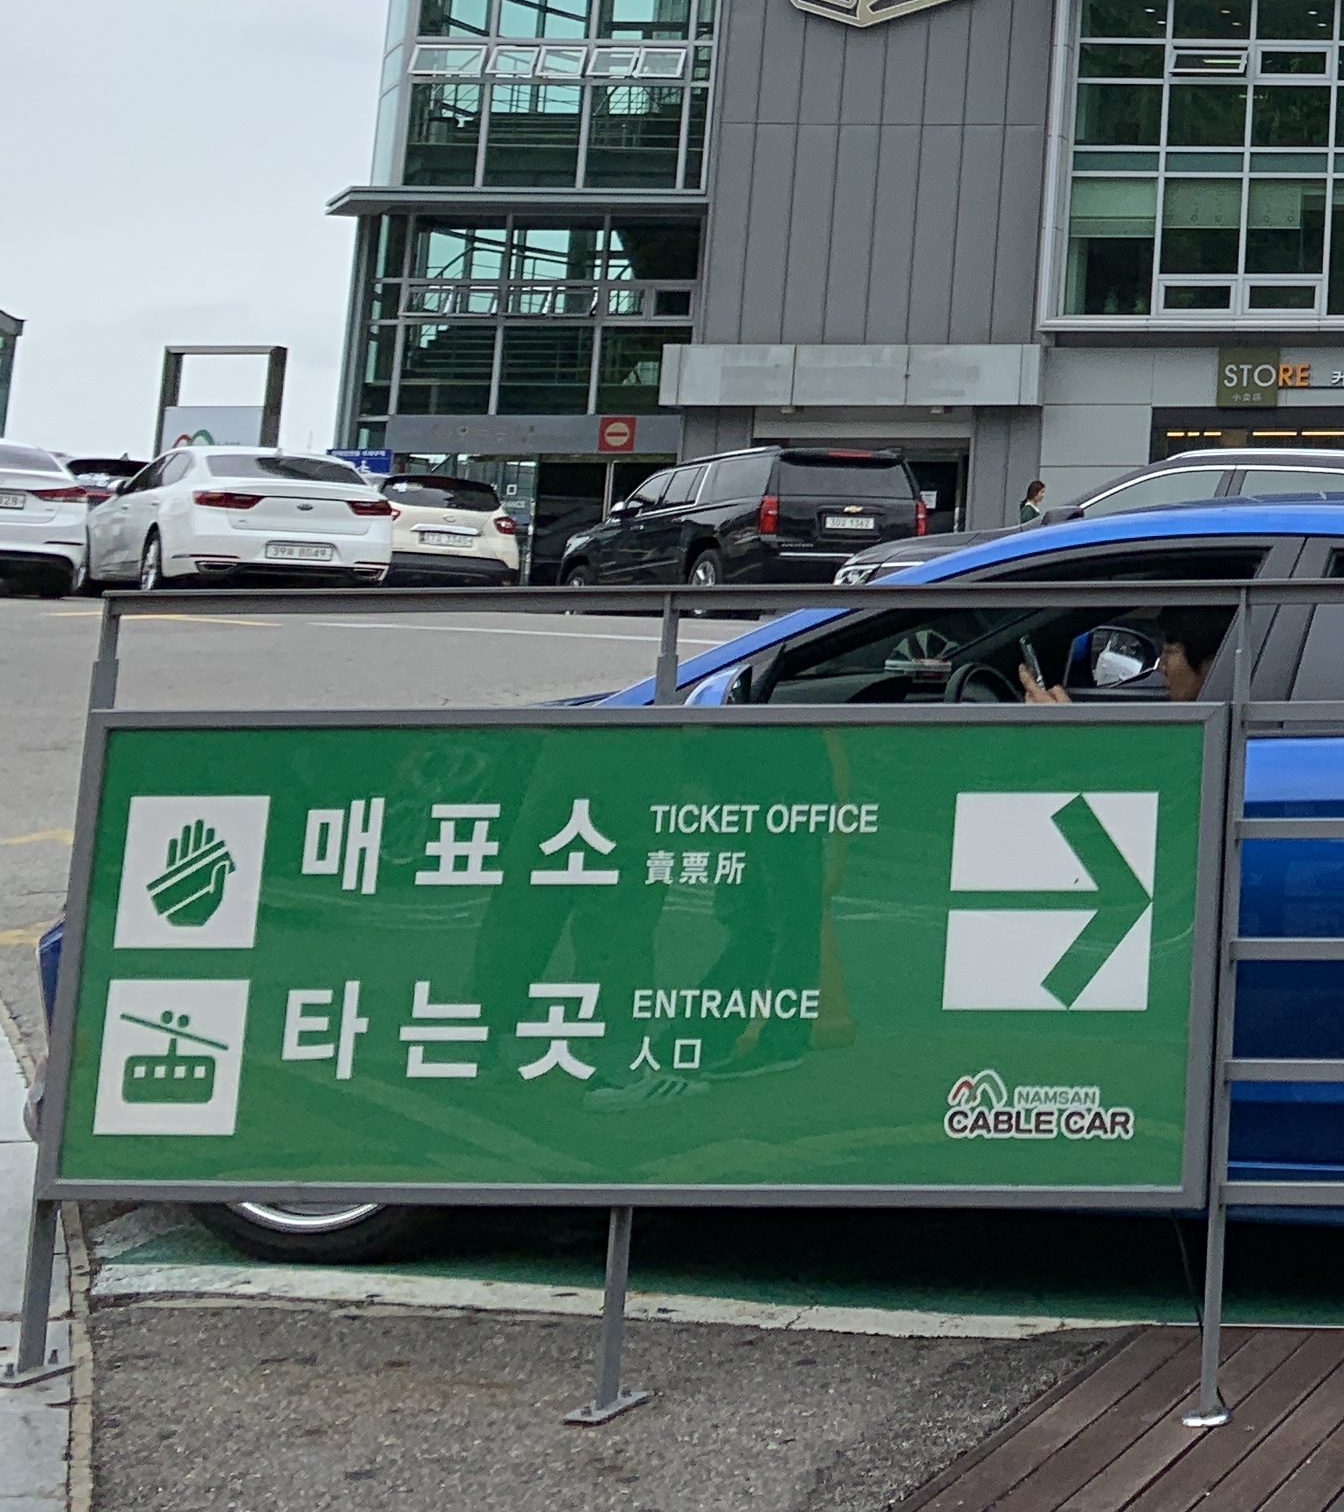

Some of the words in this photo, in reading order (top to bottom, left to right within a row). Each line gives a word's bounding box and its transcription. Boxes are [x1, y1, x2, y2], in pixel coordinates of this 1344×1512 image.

[1222, 363, 1312, 388] STORE
[648, 802, 762, 835] TICKET
[765, 802, 880, 835] OFFICE
[643, 849, 747, 886] 賣票所
[631, 987, 822, 1020] ENTRANCE
[628, 1035, 703, 1072] 入口
[1015, 1089, 1098, 1106] NAMSAN
[946, 1108, 1056, 1137] CABLE
[1062, 1109, 1132, 1137] CAR
